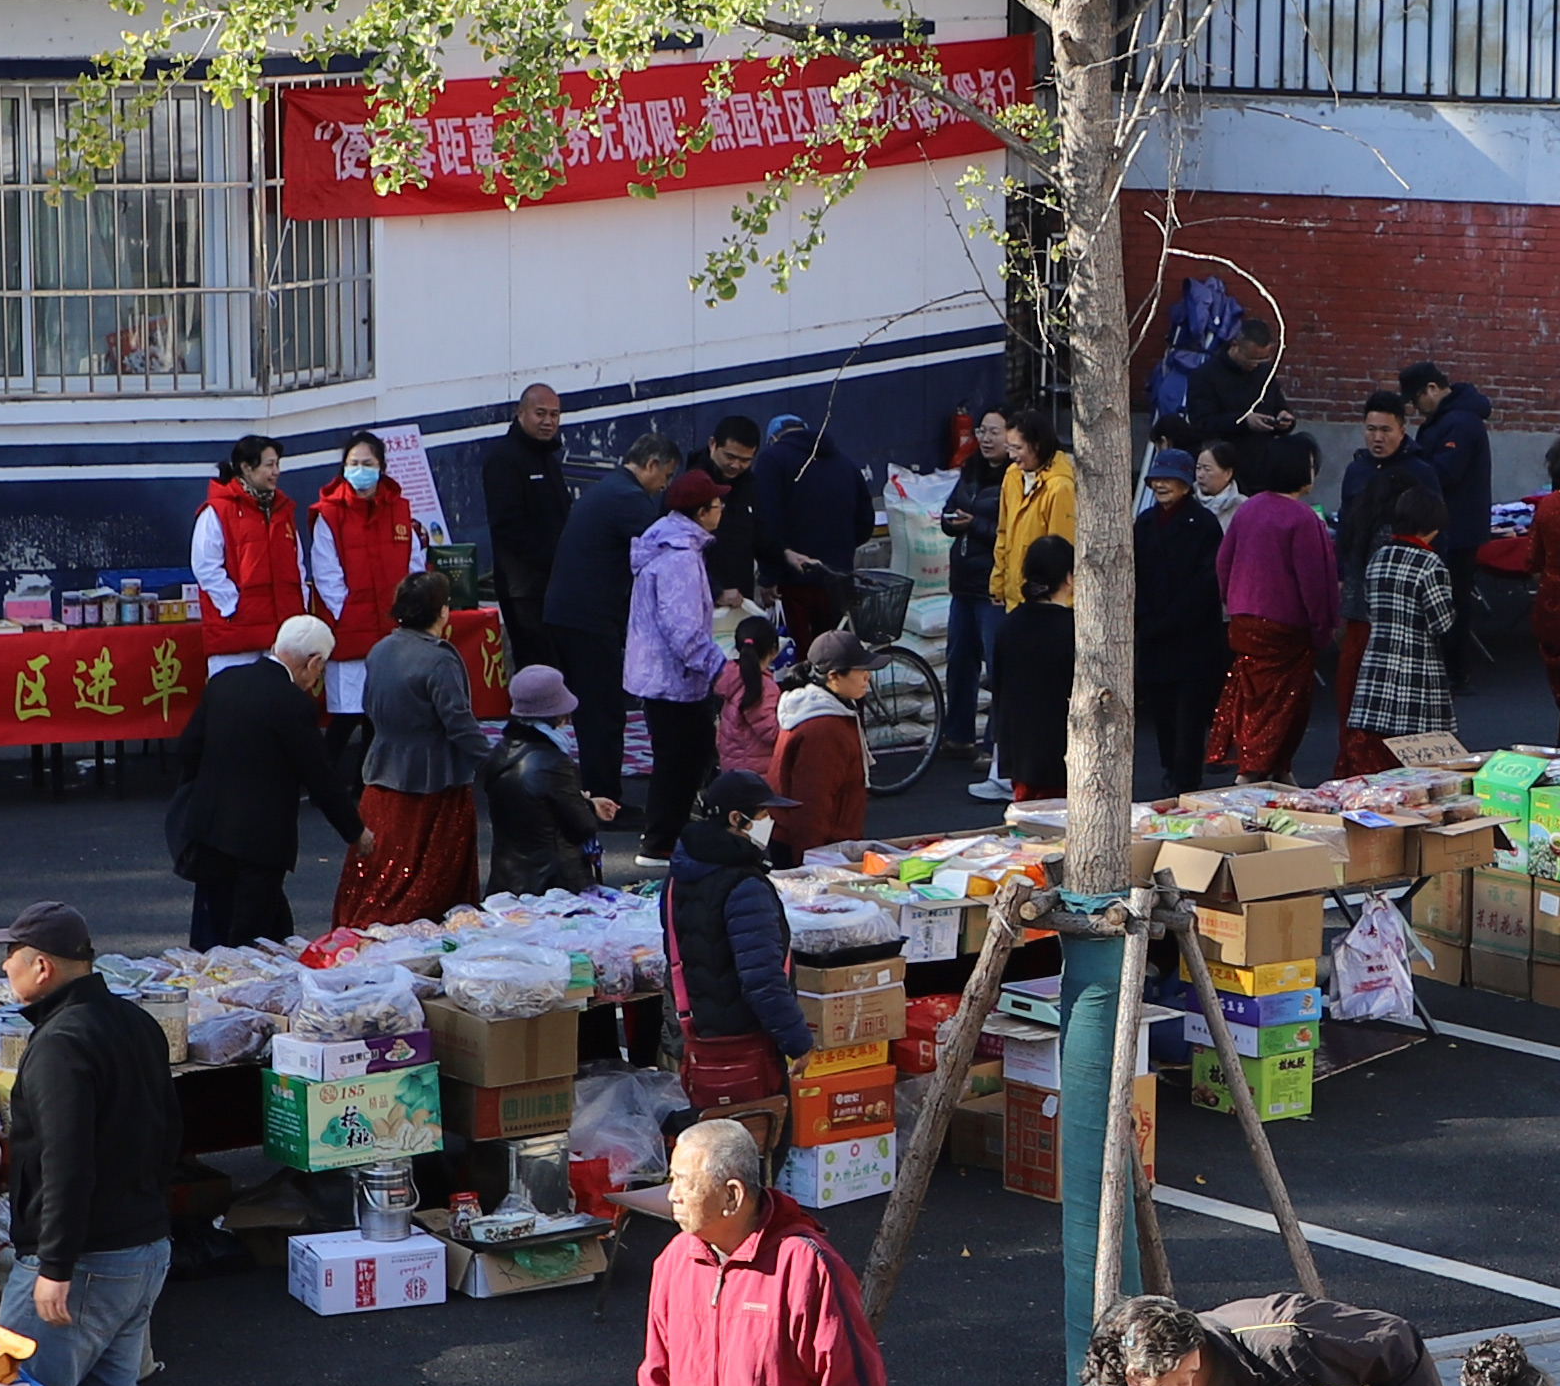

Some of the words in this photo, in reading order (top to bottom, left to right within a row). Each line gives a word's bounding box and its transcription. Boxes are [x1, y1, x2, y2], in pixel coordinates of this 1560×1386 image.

[1475, 909, 1527, 938] 茉莉花茶
[340, 1084, 365, 1100] 185
